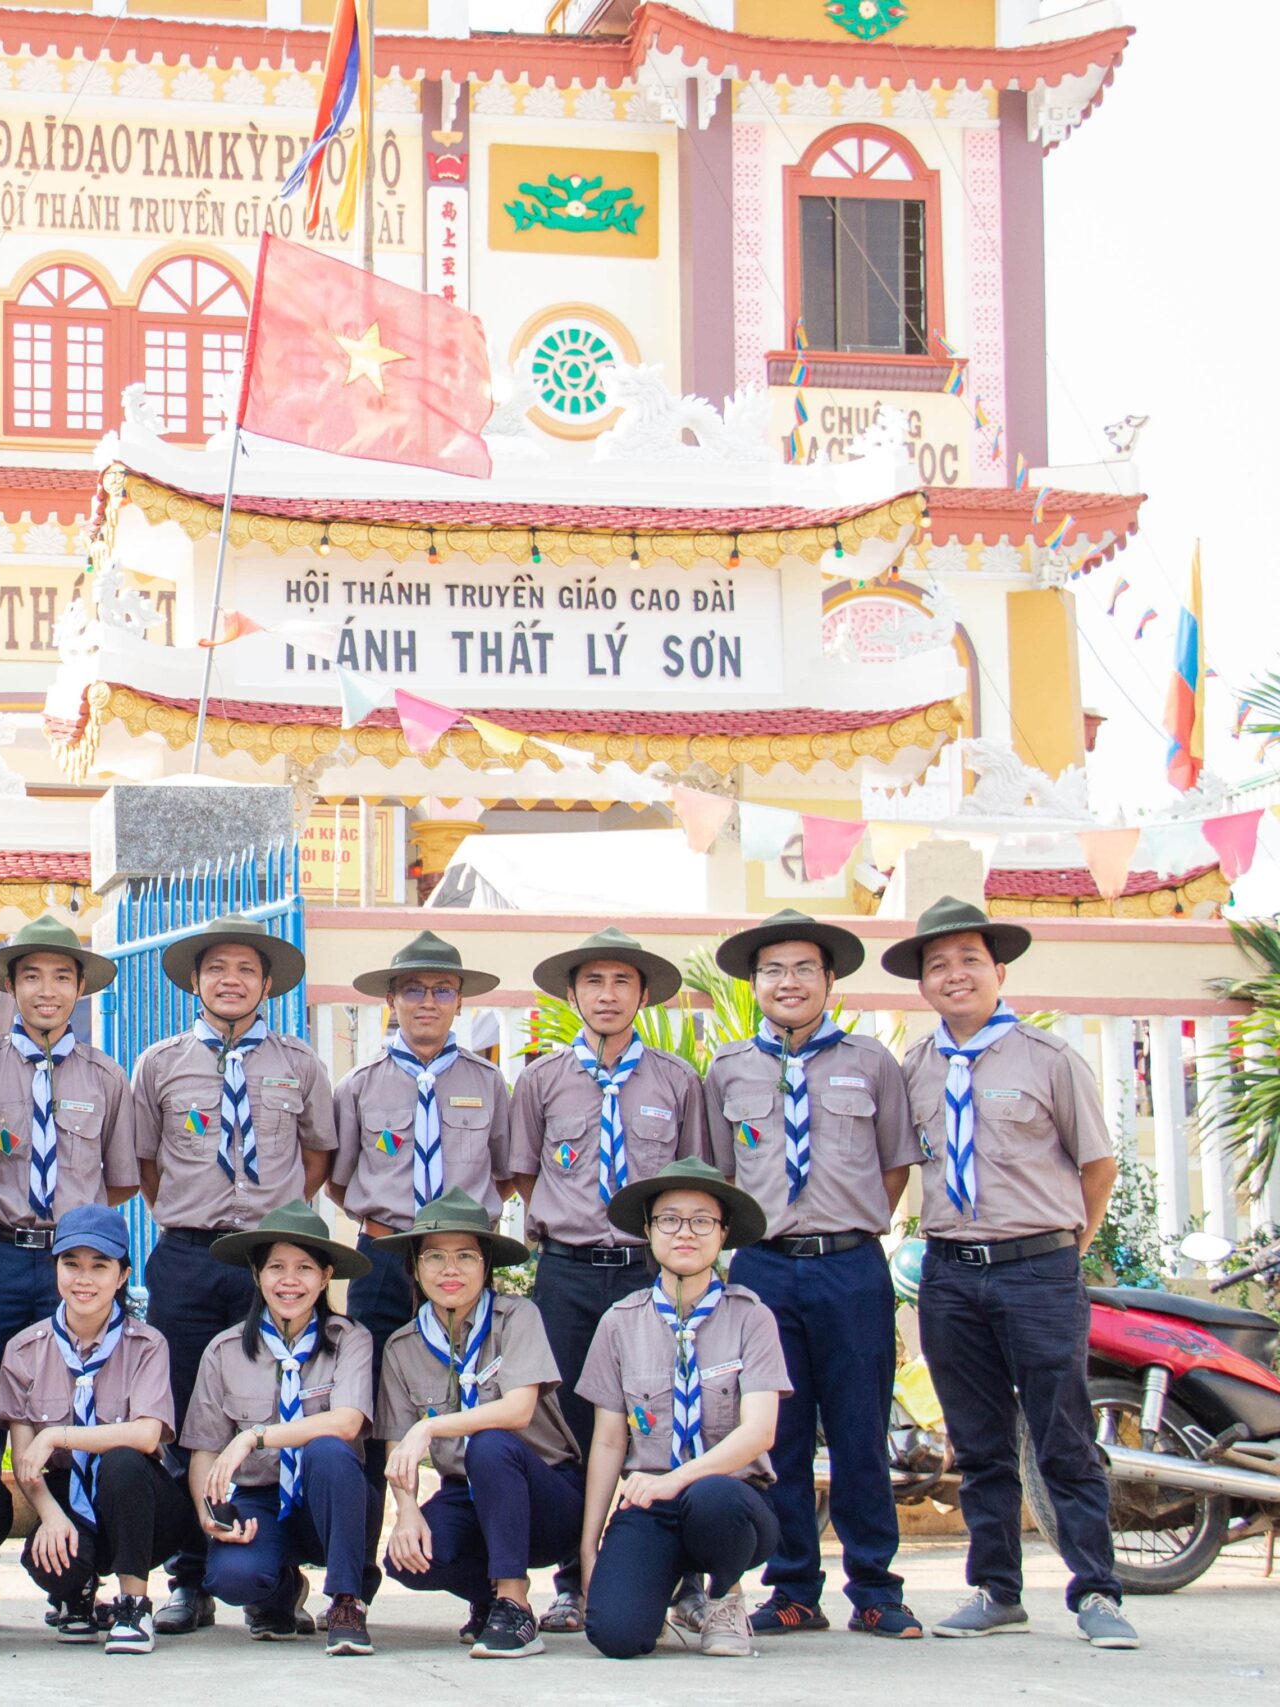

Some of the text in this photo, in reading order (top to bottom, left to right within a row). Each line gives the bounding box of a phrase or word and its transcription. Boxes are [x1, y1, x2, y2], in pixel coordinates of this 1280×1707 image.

[35, 186, 120, 231] THÁNH
[130, 188, 225, 236] TRUYỀN
[371, 201, 406, 245] ÀI
[286, 570, 735, 612] HỘI THÁNH TRUYỀN GIÁO CAO ĐÀI
[451, 620, 554, 674] THẤT
[587, 622, 628, 675] LÝ
[663, 630, 741, 678] SƠN
